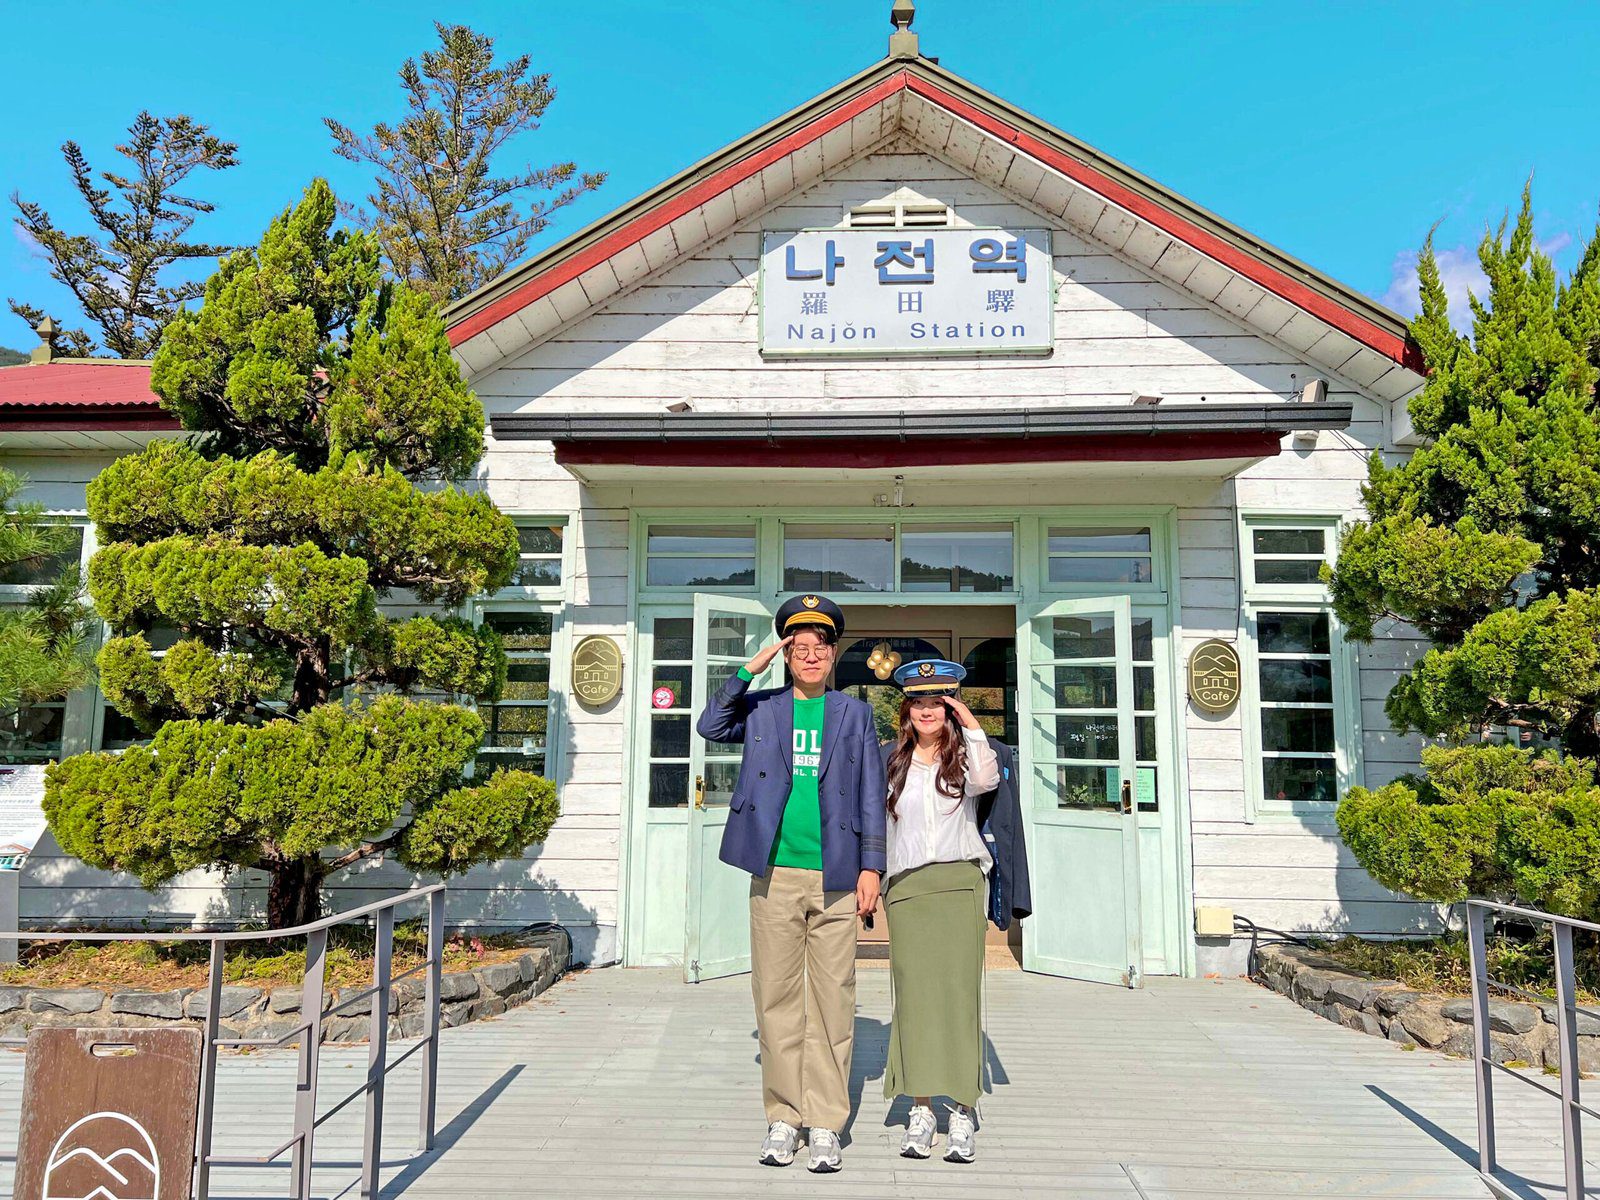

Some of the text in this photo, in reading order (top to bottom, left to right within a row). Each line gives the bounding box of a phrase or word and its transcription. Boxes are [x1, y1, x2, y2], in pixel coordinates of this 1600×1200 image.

[786, 236, 1027, 286] 나전역
[910, 321, 1025, 338] Station
[582, 685, 609, 694] Cafe
[1202, 691, 1230, 700] Cafe
